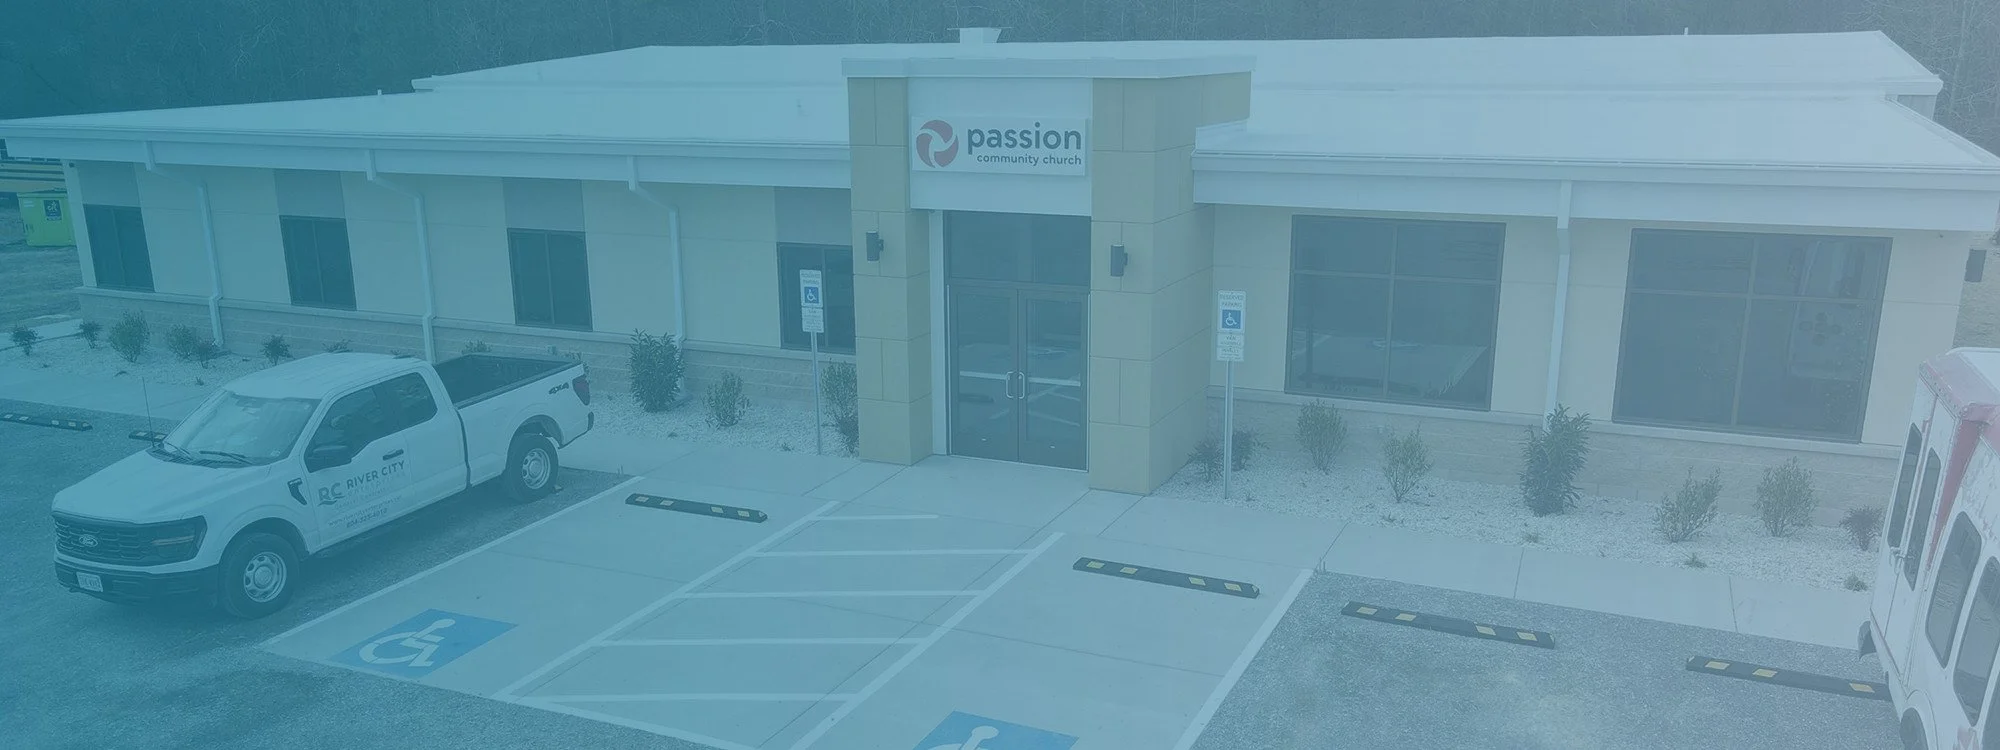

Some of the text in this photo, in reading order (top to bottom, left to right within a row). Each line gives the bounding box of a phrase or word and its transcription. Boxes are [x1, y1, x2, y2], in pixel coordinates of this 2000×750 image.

[967, 122, 1082, 155] passion
[977, 153, 1082, 167] community church
[346, 470, 379, 490] RIVER
[381, 460, 405, 476] CITY
